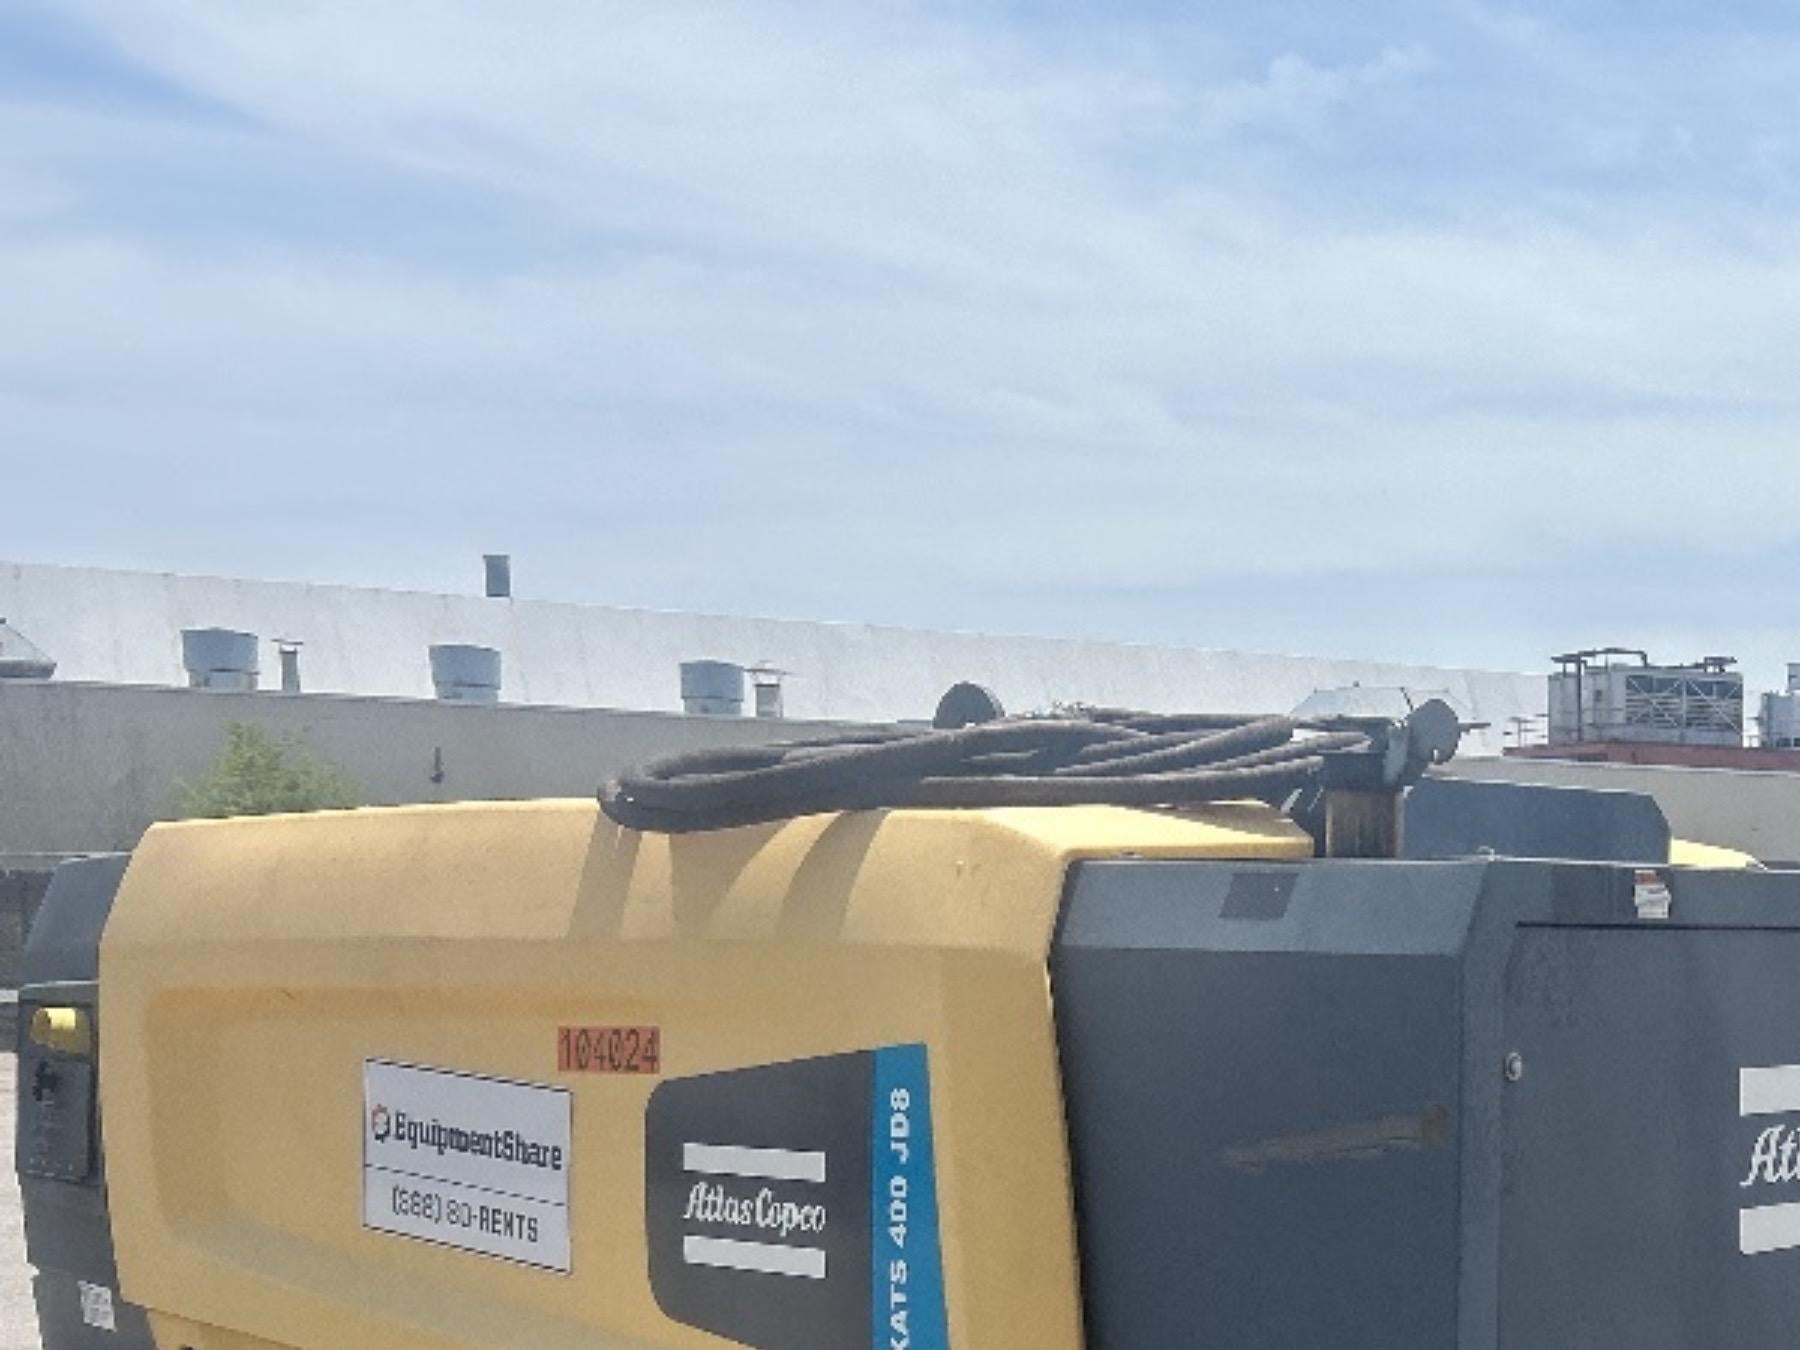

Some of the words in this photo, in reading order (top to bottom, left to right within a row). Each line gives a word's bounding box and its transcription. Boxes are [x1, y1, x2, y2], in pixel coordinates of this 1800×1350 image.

[560, 1027, 658, 1072] 104024
[395, 1110, 563, 1171] EquipmentShare
[889, 1087, 911, 1164] JD8
[683, 1181, 753, 1225] Atlas
[755, 1187, 826, 1237] Copco
[888, 1175, 908, 1249] 400
